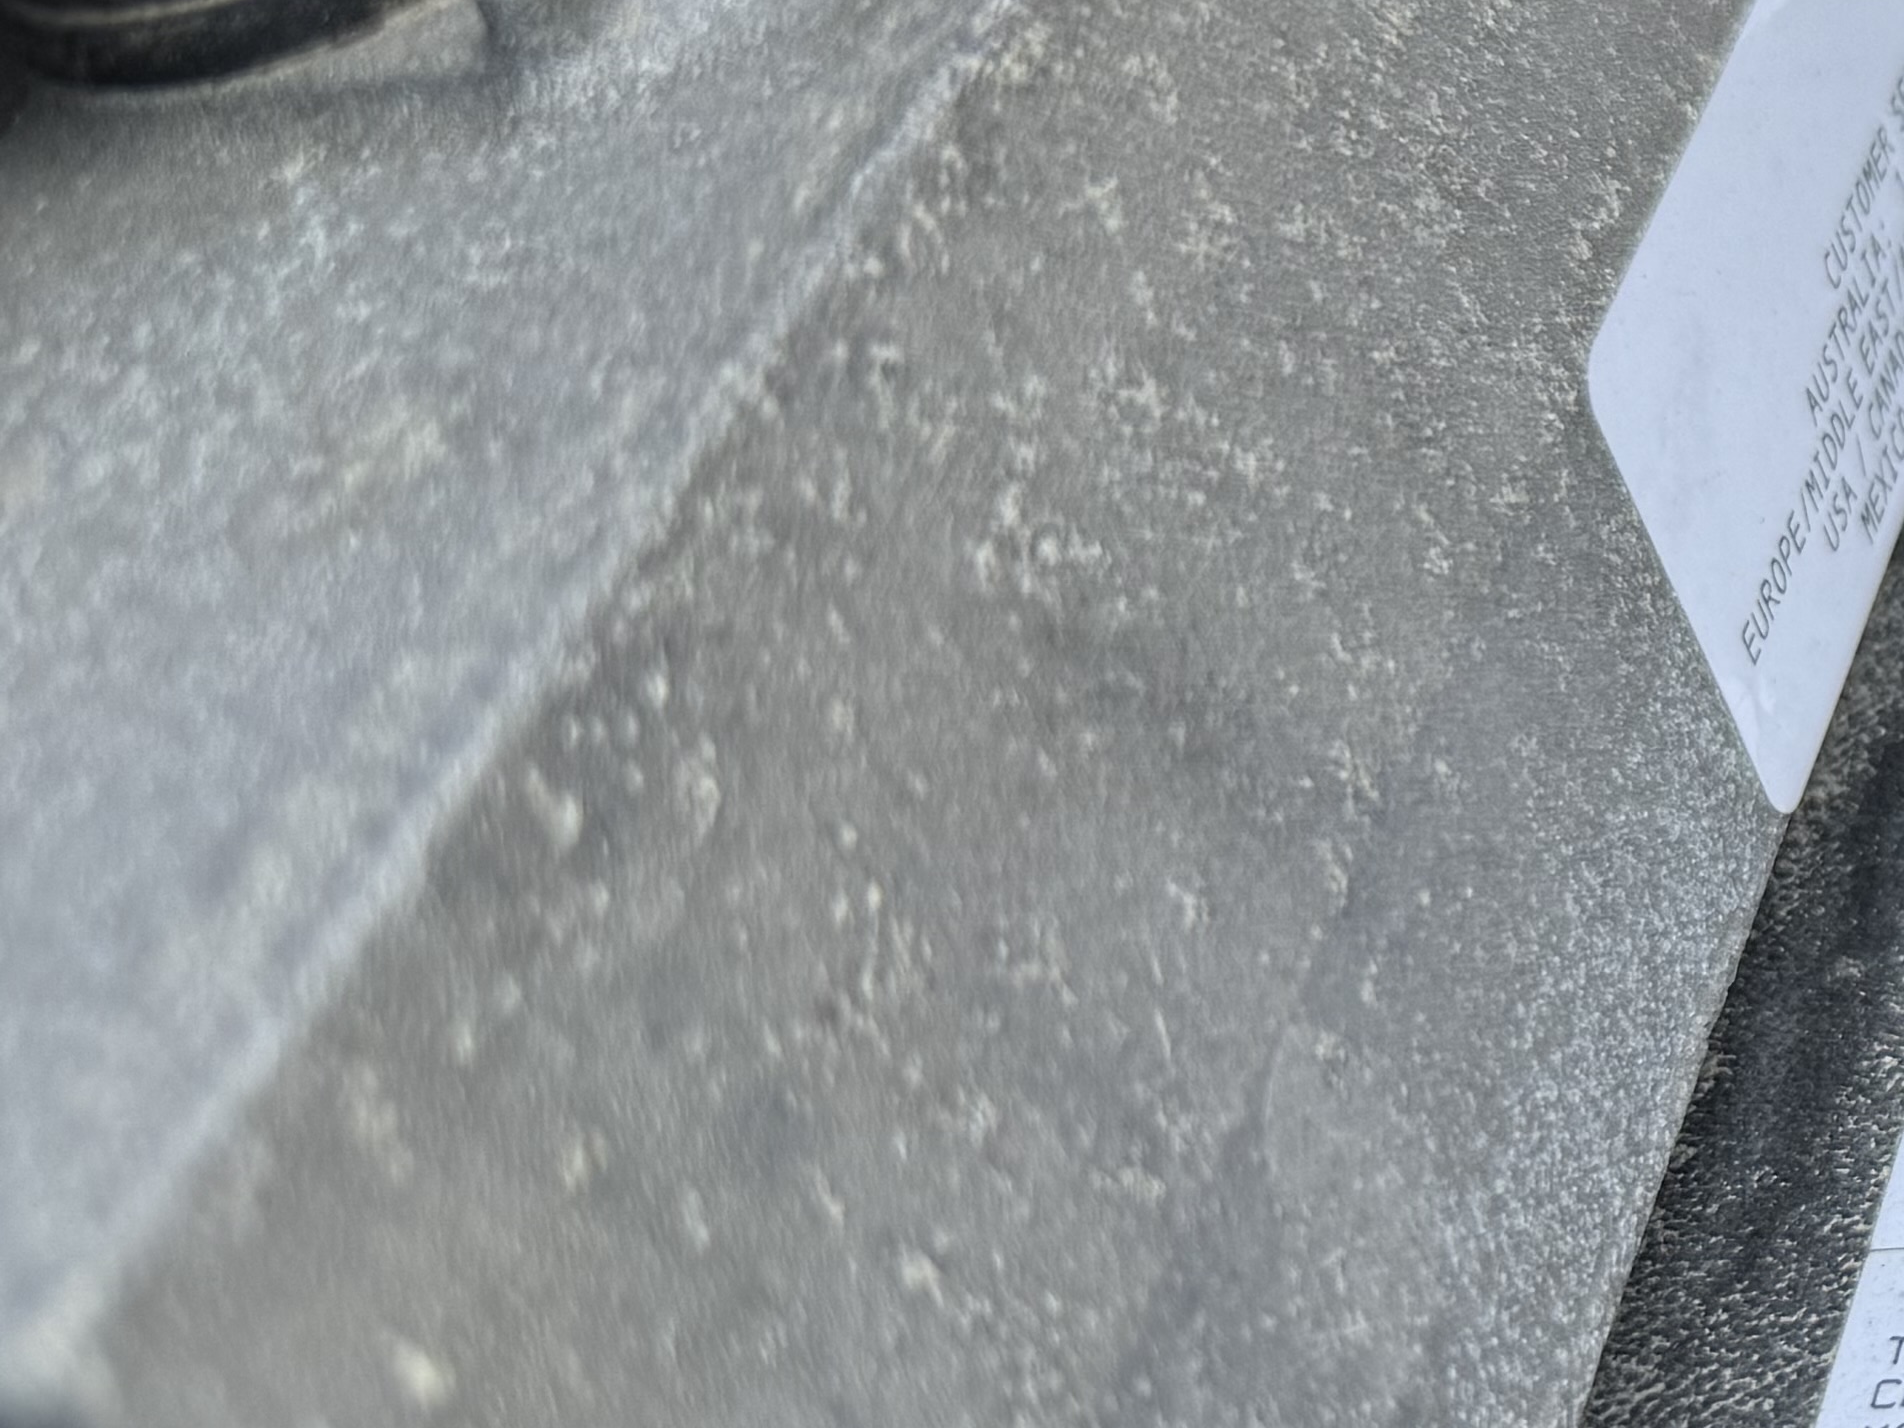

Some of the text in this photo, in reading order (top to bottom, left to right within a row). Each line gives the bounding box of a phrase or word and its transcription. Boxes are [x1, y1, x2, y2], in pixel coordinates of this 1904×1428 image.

[1821, 119, 1895, 297] CUSTOMER
[1803, 210, 1893, 430] AUSTRALIA:
[1740, 363, 1865, 671] EUROPE/MIDDLE
[1821, 469, 1857, 556] USA
